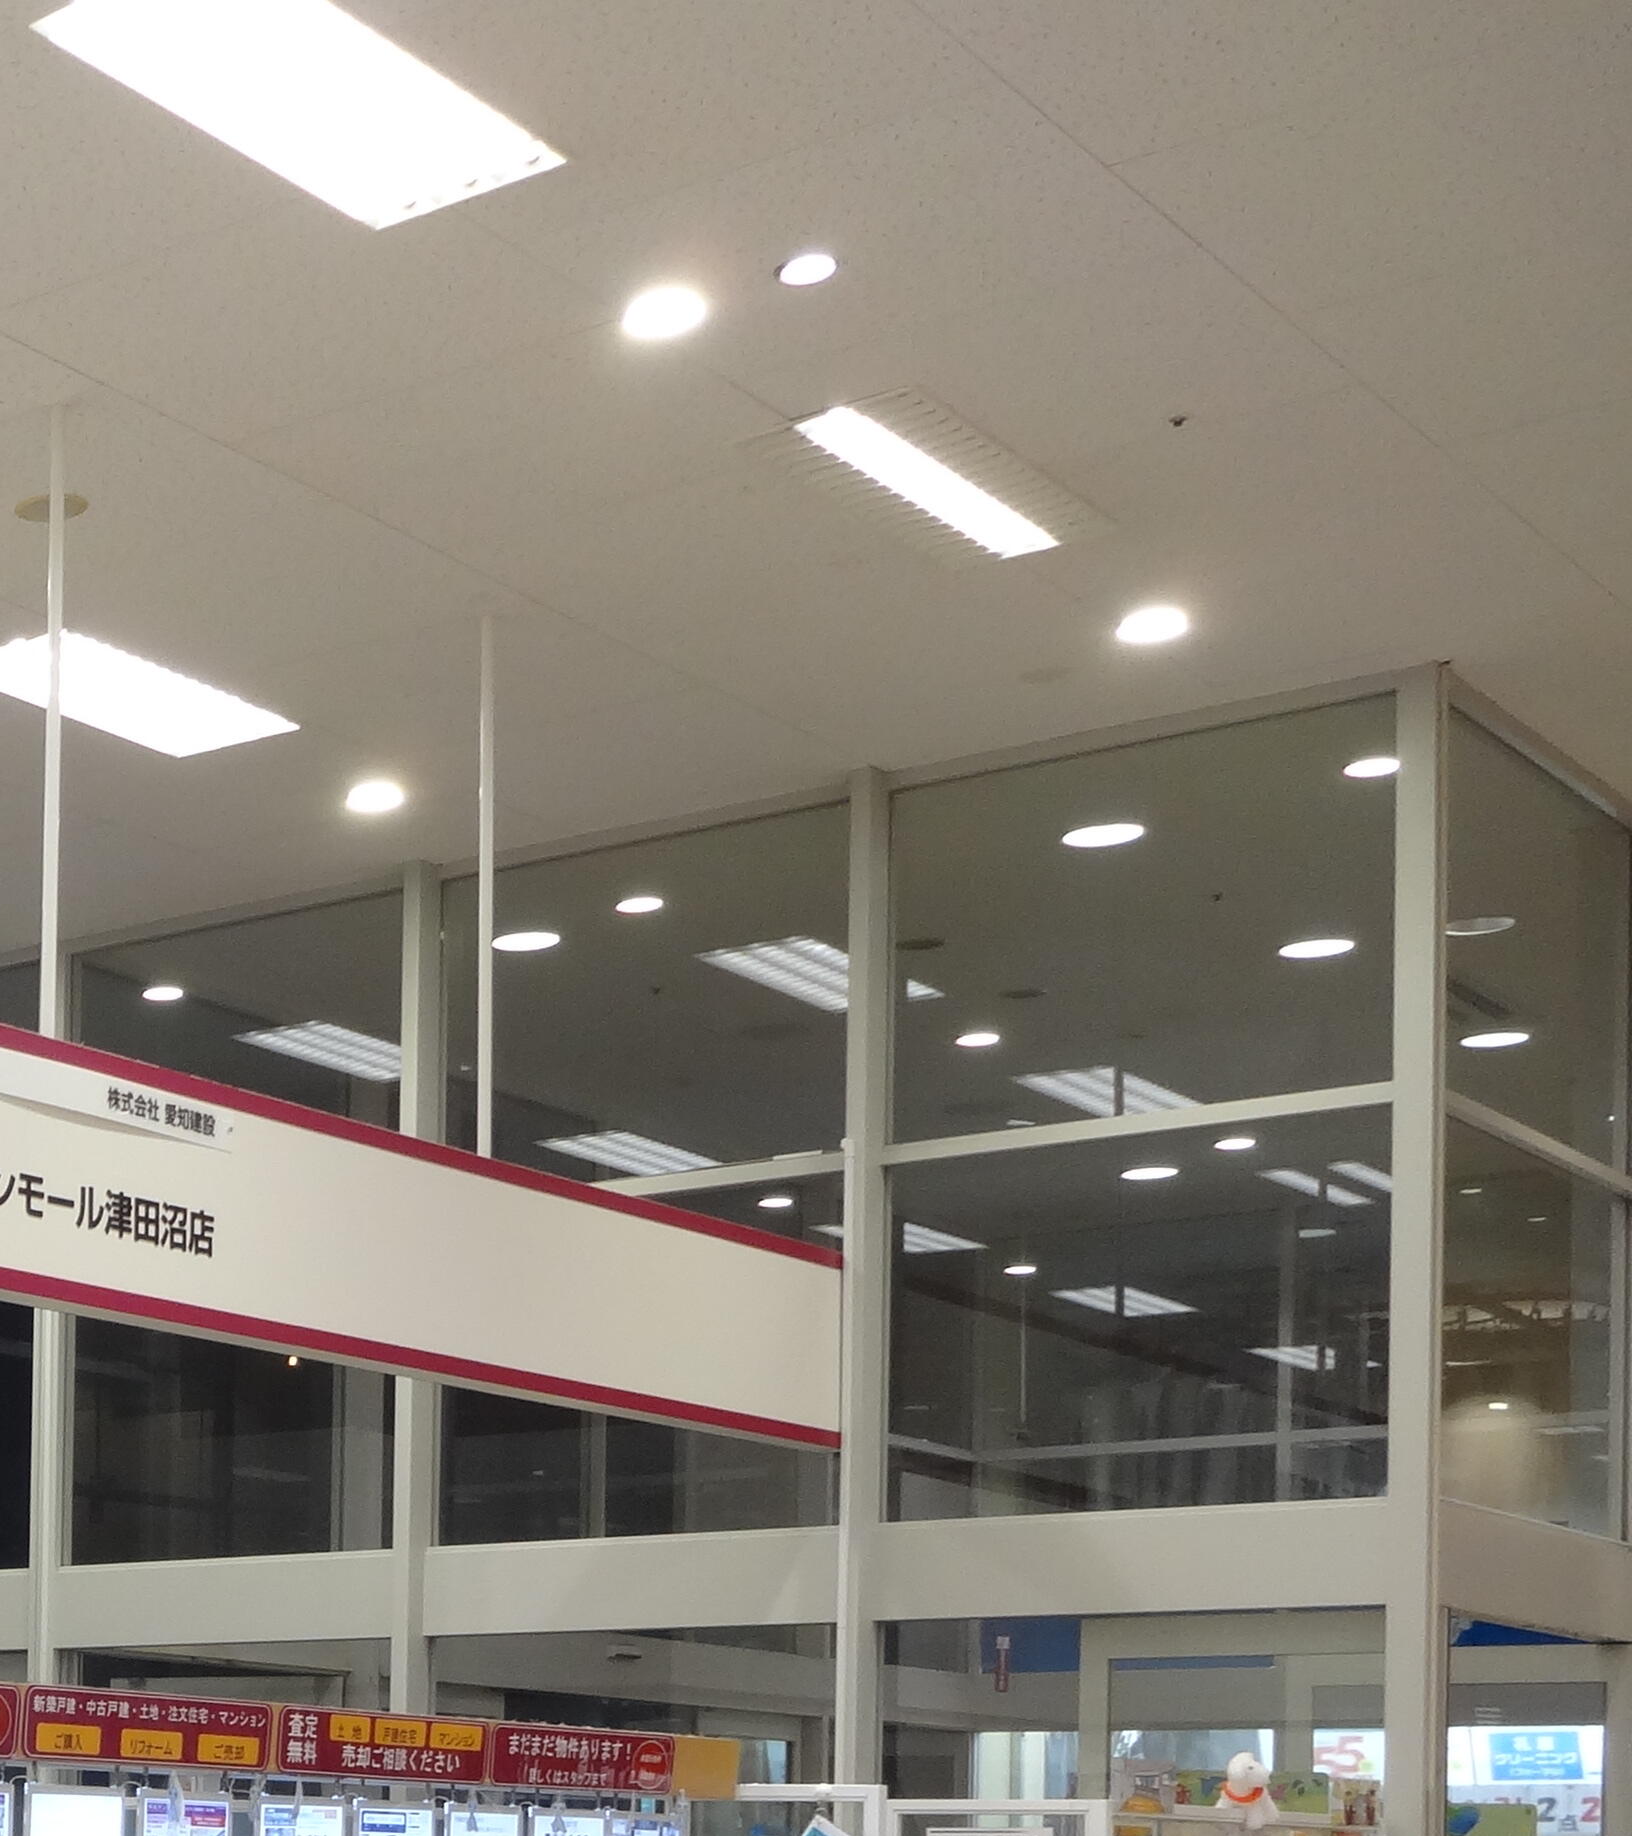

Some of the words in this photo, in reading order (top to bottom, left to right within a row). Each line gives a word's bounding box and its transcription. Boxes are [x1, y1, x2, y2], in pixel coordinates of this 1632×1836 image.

[108, 1086, 159, 1122] 株式会社
[164, 1104, 215, 1137] 愛知建設
[288, 1713, 318, 1738] 査定
[129, 1738, 174, 1756] リフォーム
[287, 1740, 318, 1765] 無料
[342, 1743, 460, 1773] 売却ご相談ください
[1495, 1752, 1577, 1765] クリーニング
